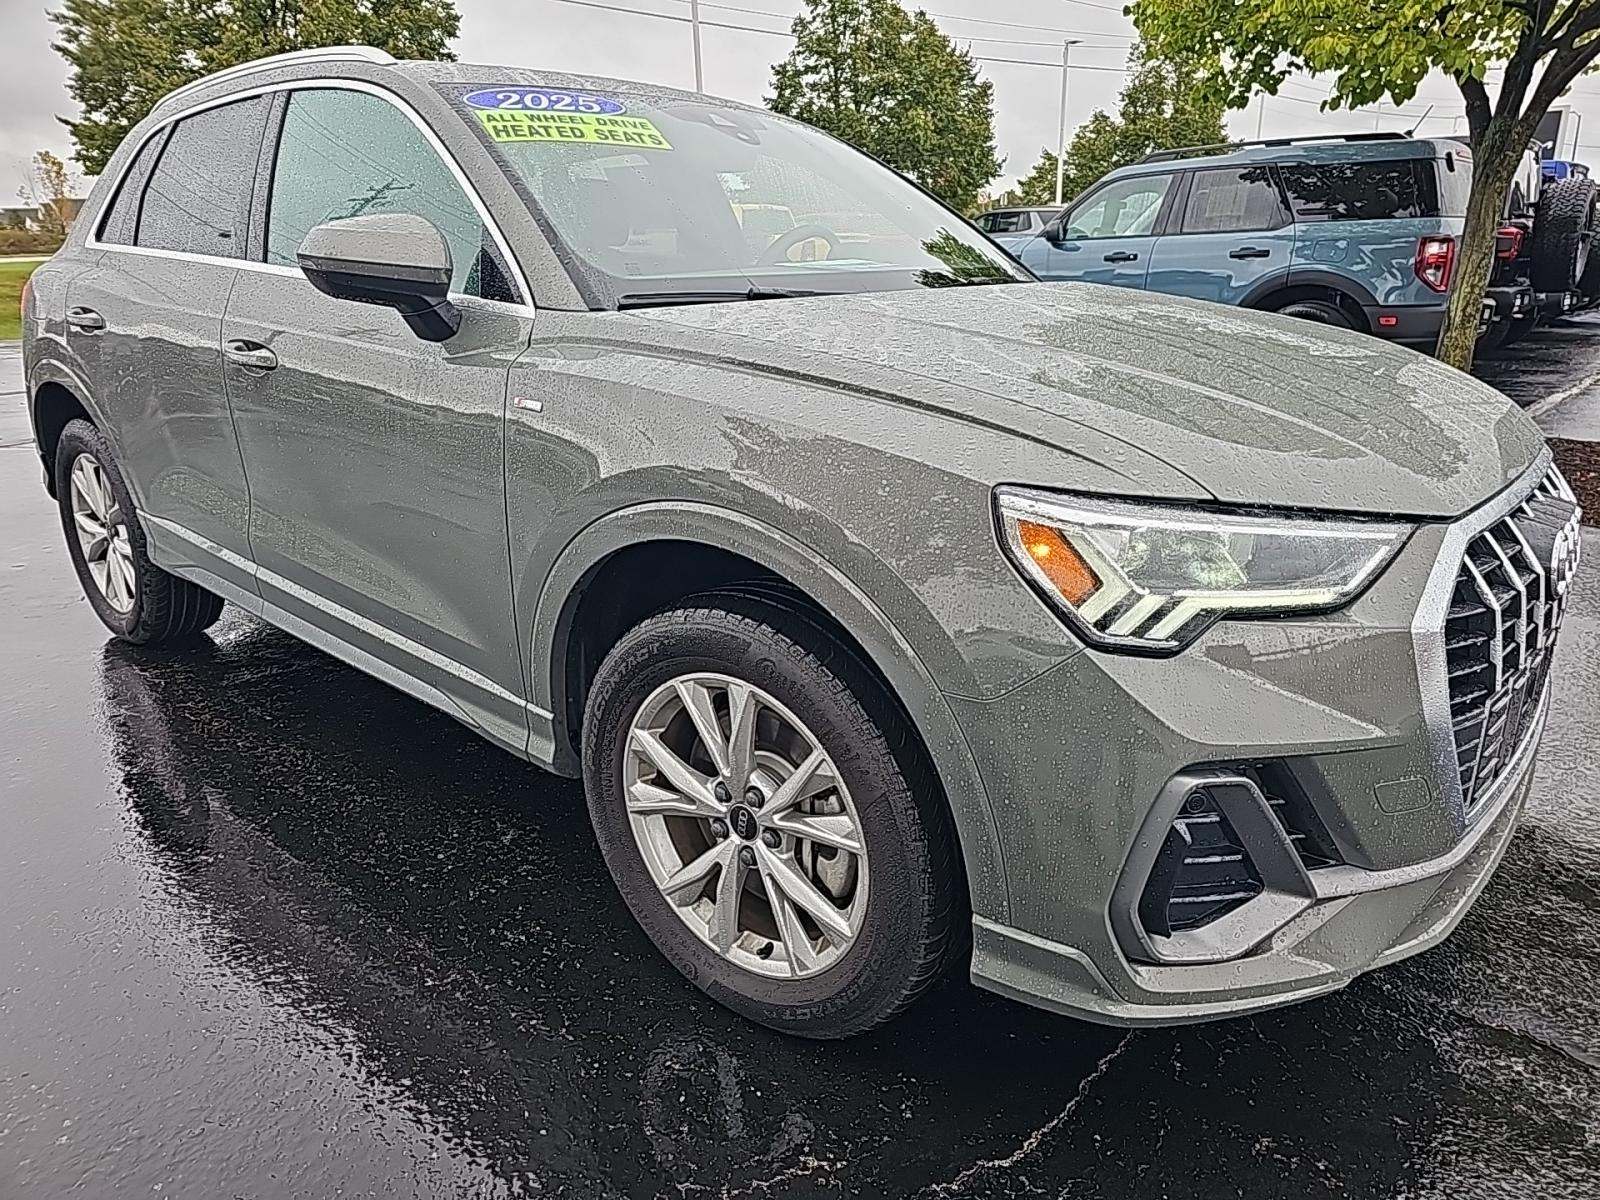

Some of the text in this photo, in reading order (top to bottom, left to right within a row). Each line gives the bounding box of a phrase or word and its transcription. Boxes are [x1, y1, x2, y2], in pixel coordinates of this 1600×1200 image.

[497, 92, 602, 113] 2025
[486, 113, 652, 130] ALL WHEEL DRIVE
[492, 124, 663, 145] HEATED SEATS
